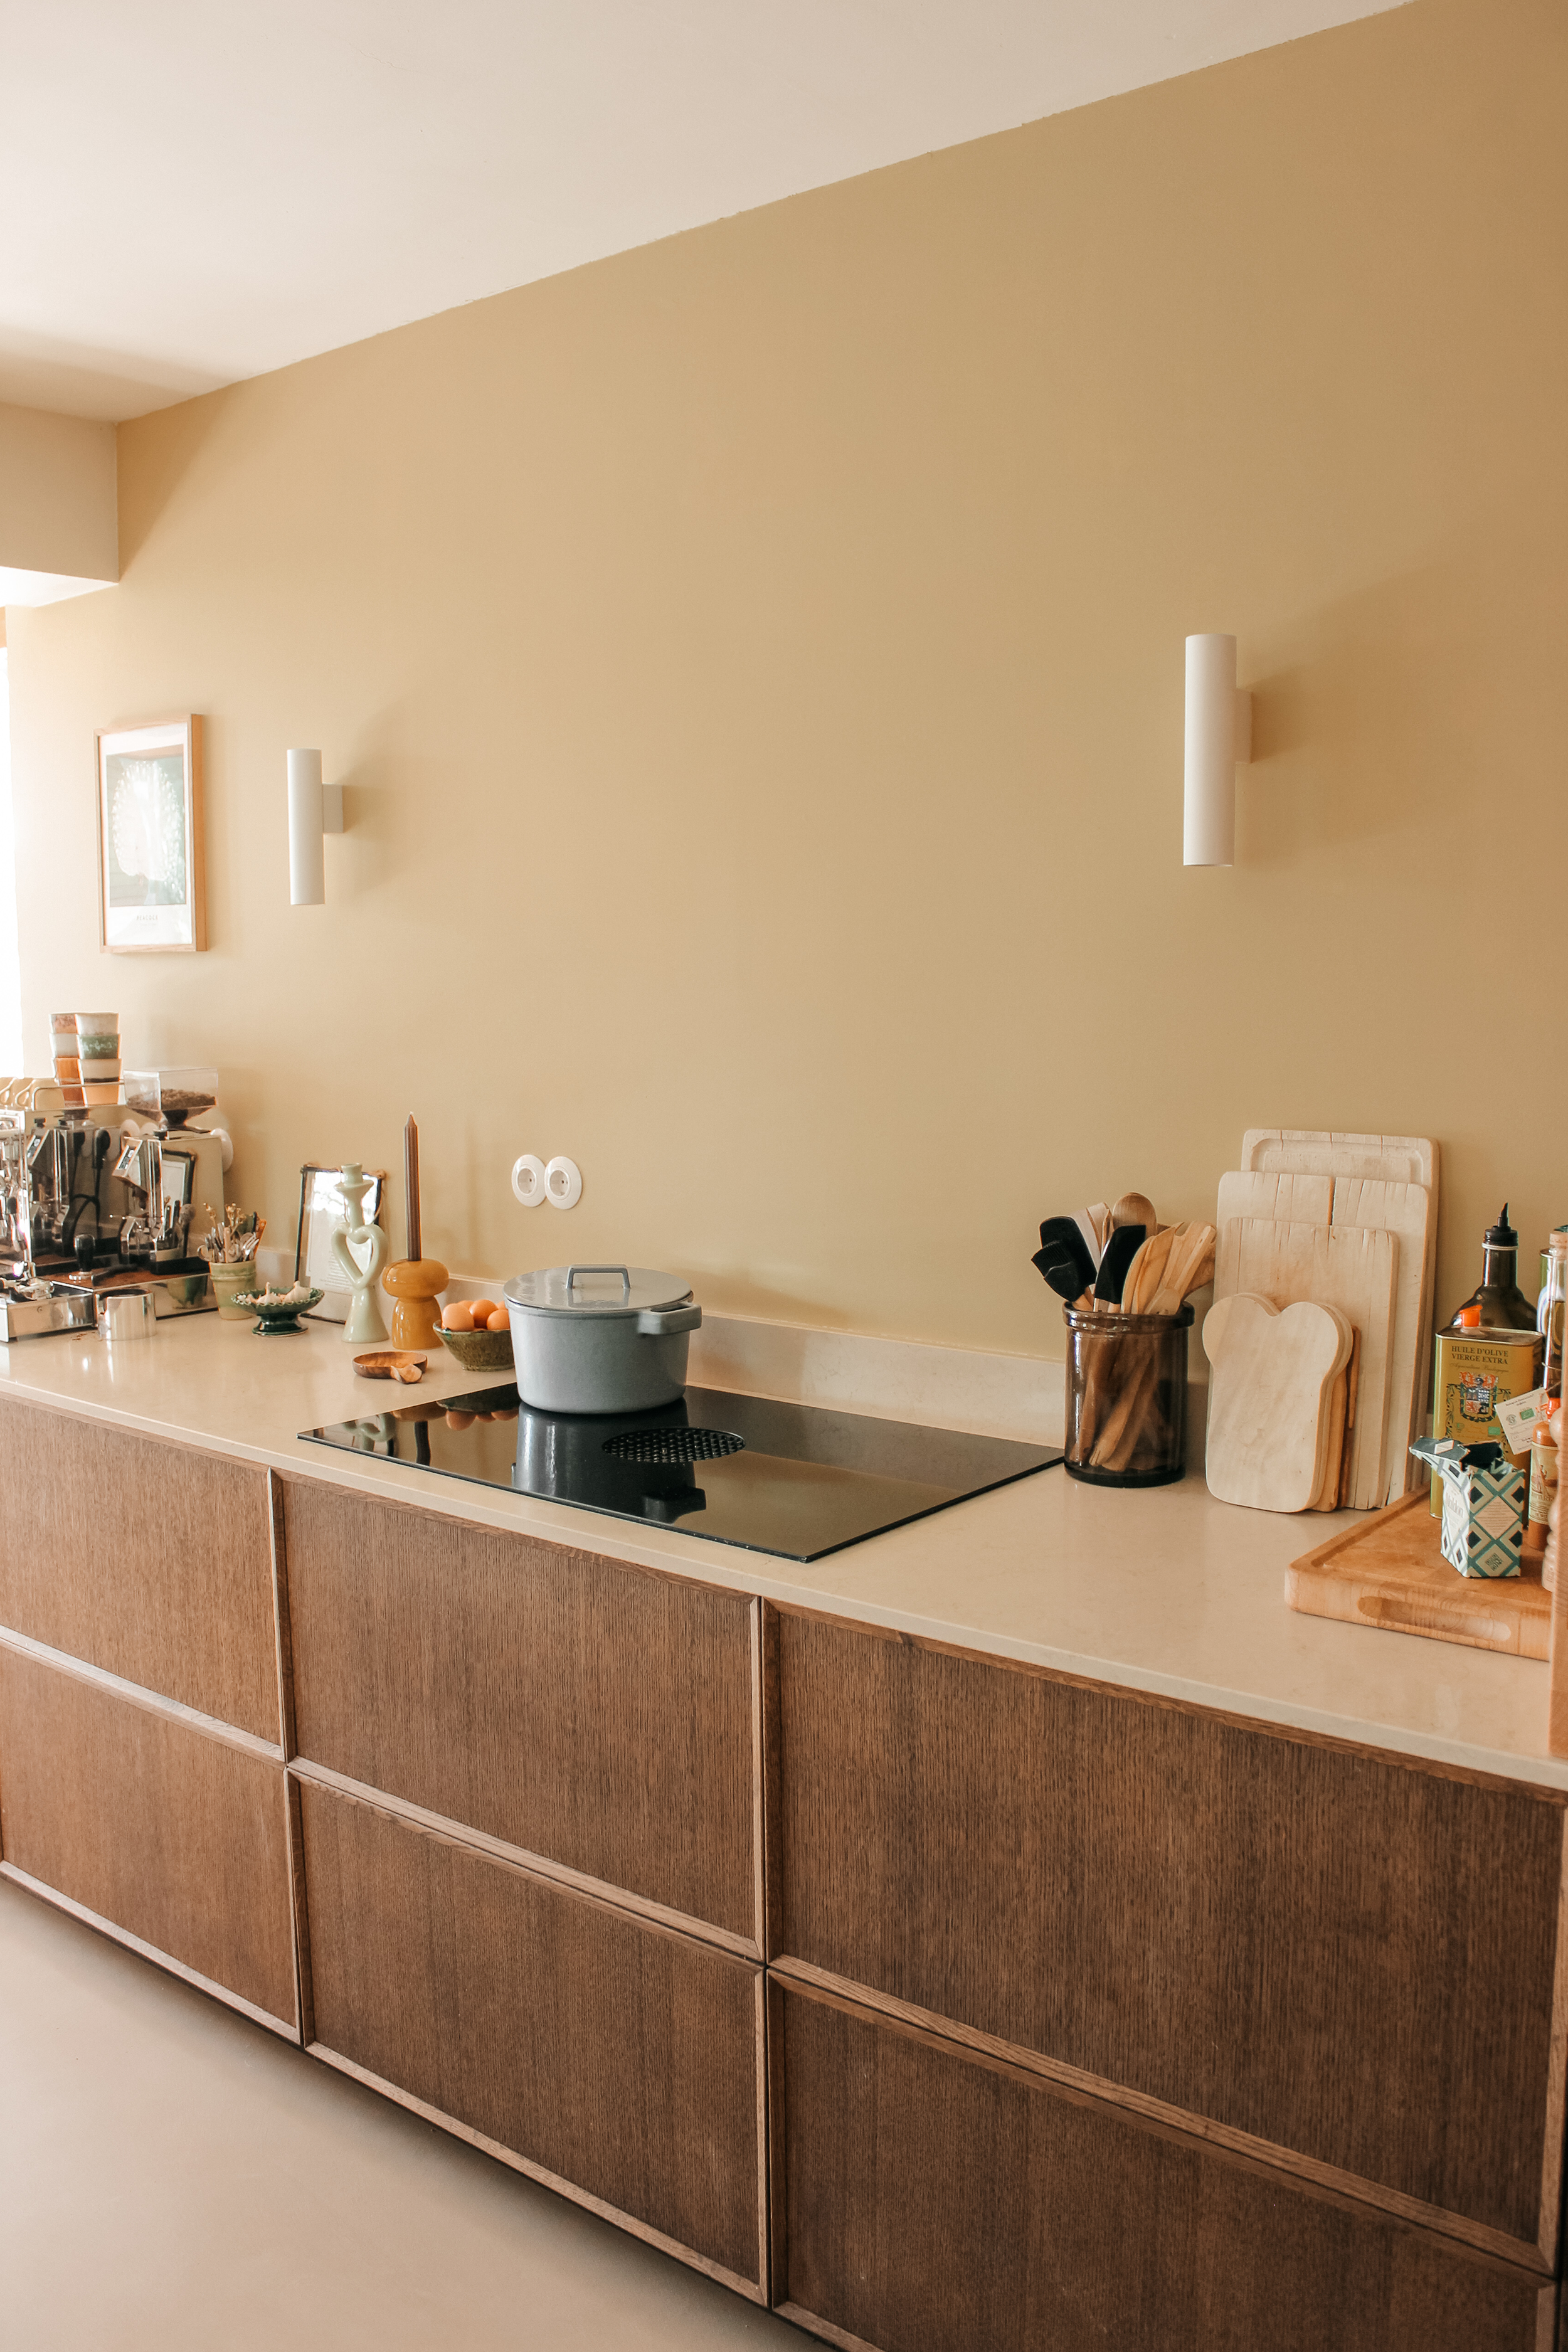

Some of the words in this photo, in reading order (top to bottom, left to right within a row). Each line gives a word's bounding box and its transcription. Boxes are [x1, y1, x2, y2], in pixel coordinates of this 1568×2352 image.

[1451, 1345, 1475, 1354] HUILE
[1477, 1348, 1508, 1357] D'OLIVE
[1451, 1353, 1480, 1362] VIERGE
[1482, 1356, 1508, 1365] EXTRA
